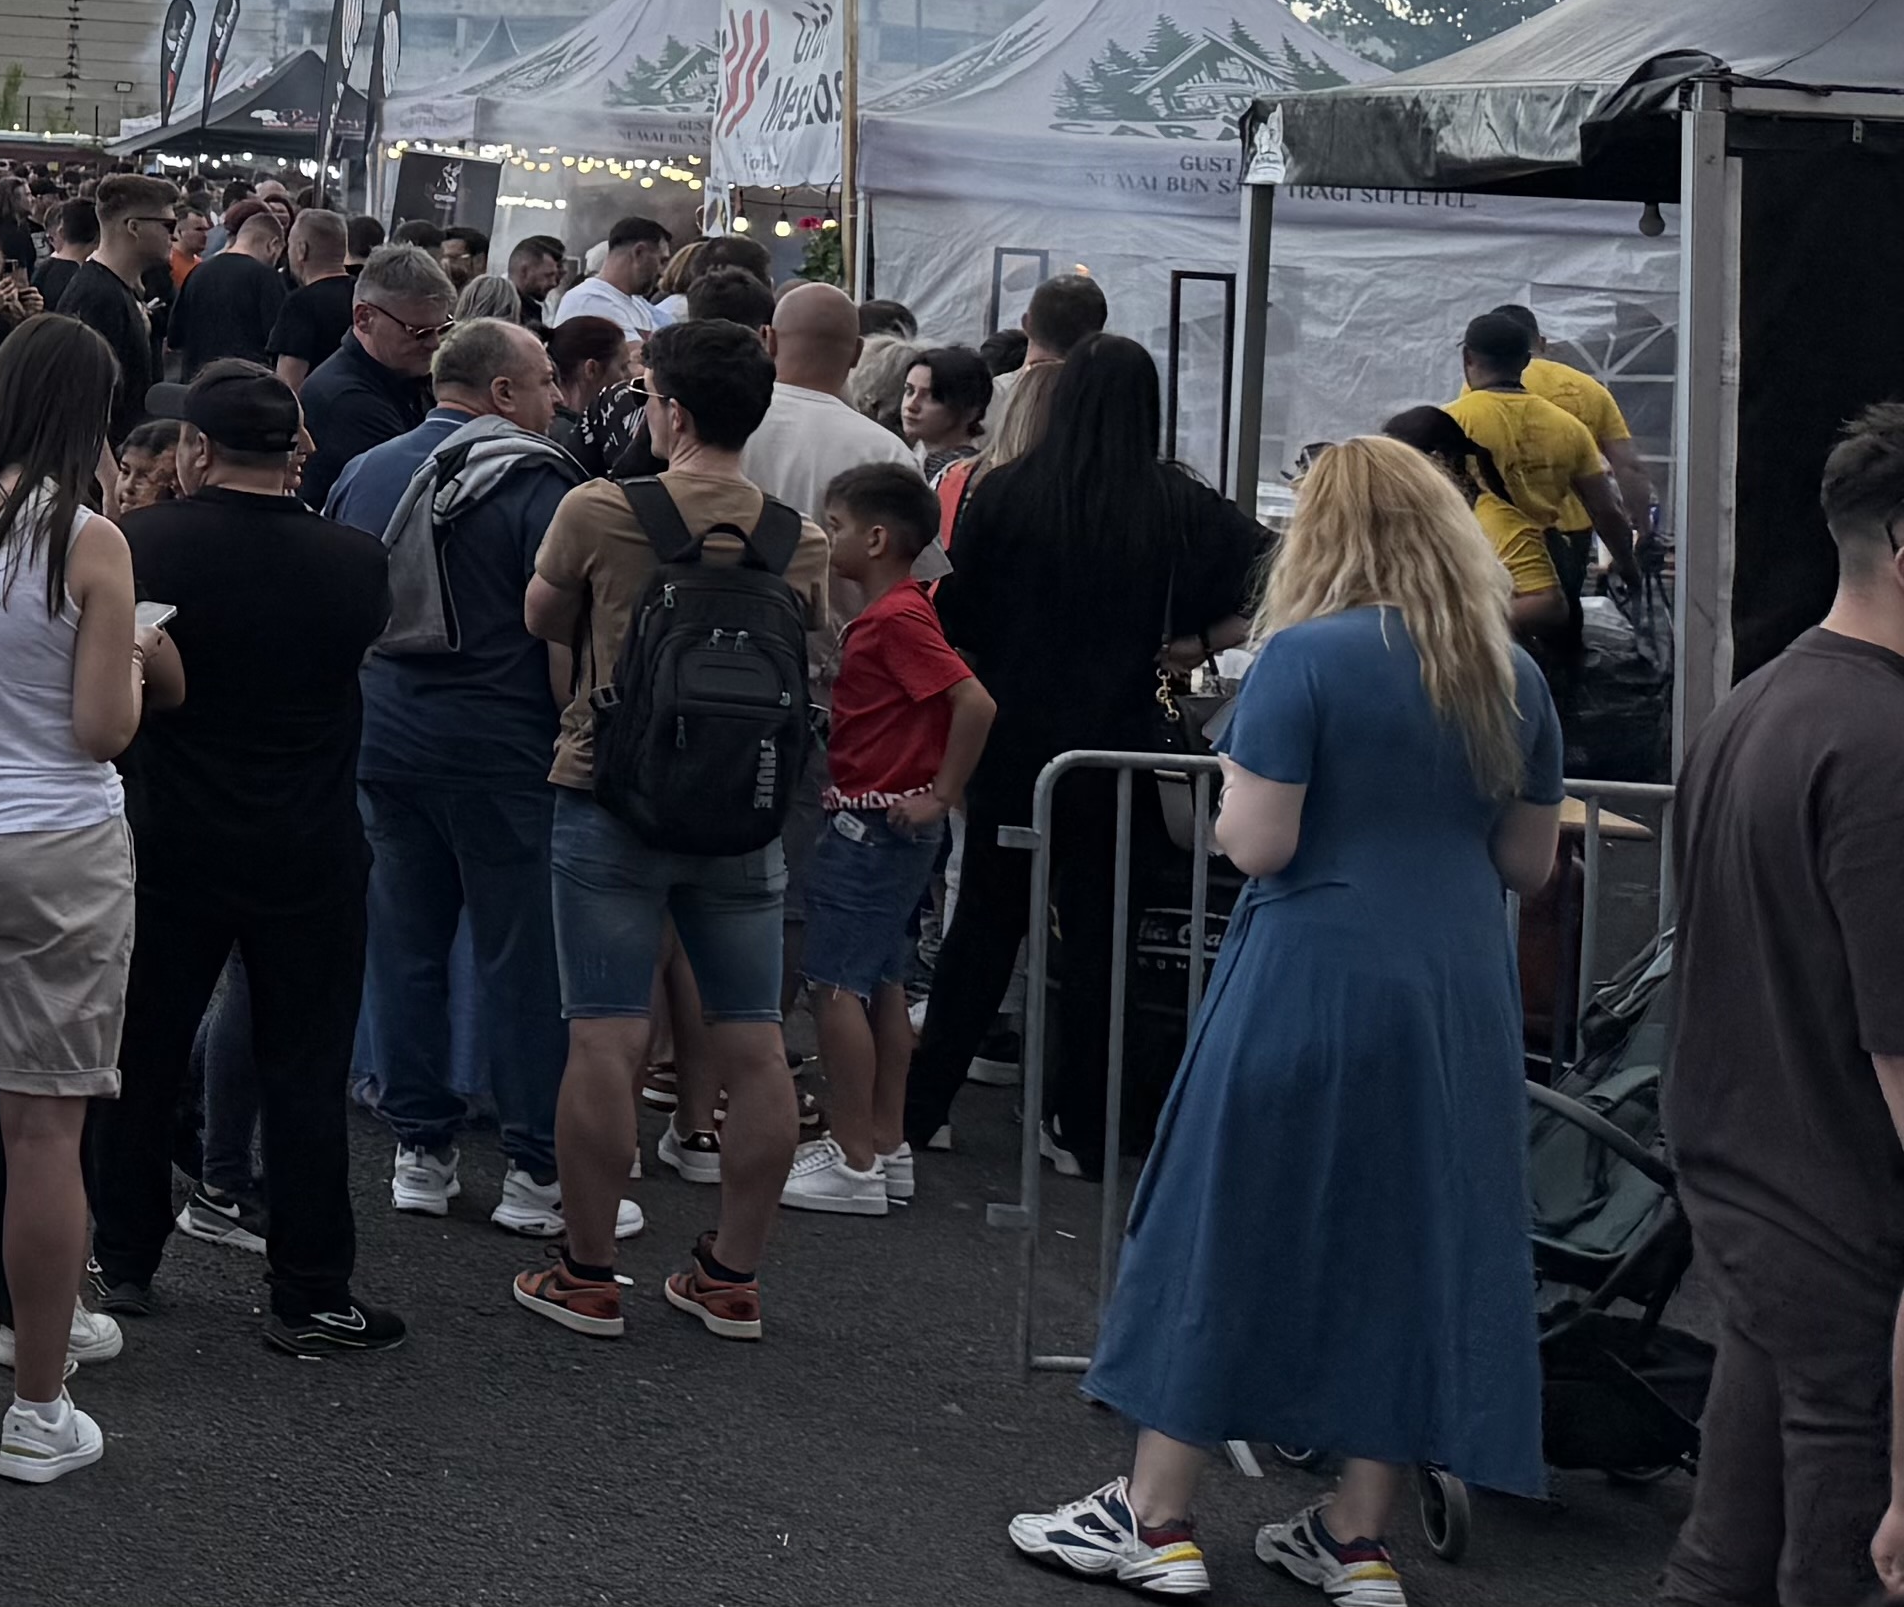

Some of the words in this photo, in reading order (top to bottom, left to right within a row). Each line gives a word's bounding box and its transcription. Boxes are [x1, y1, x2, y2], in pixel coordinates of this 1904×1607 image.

[1180, 155, 1236, 173] GUST
[1166, 176, 1210, 193] BUN
[755, 736, 777, 810] THULE
